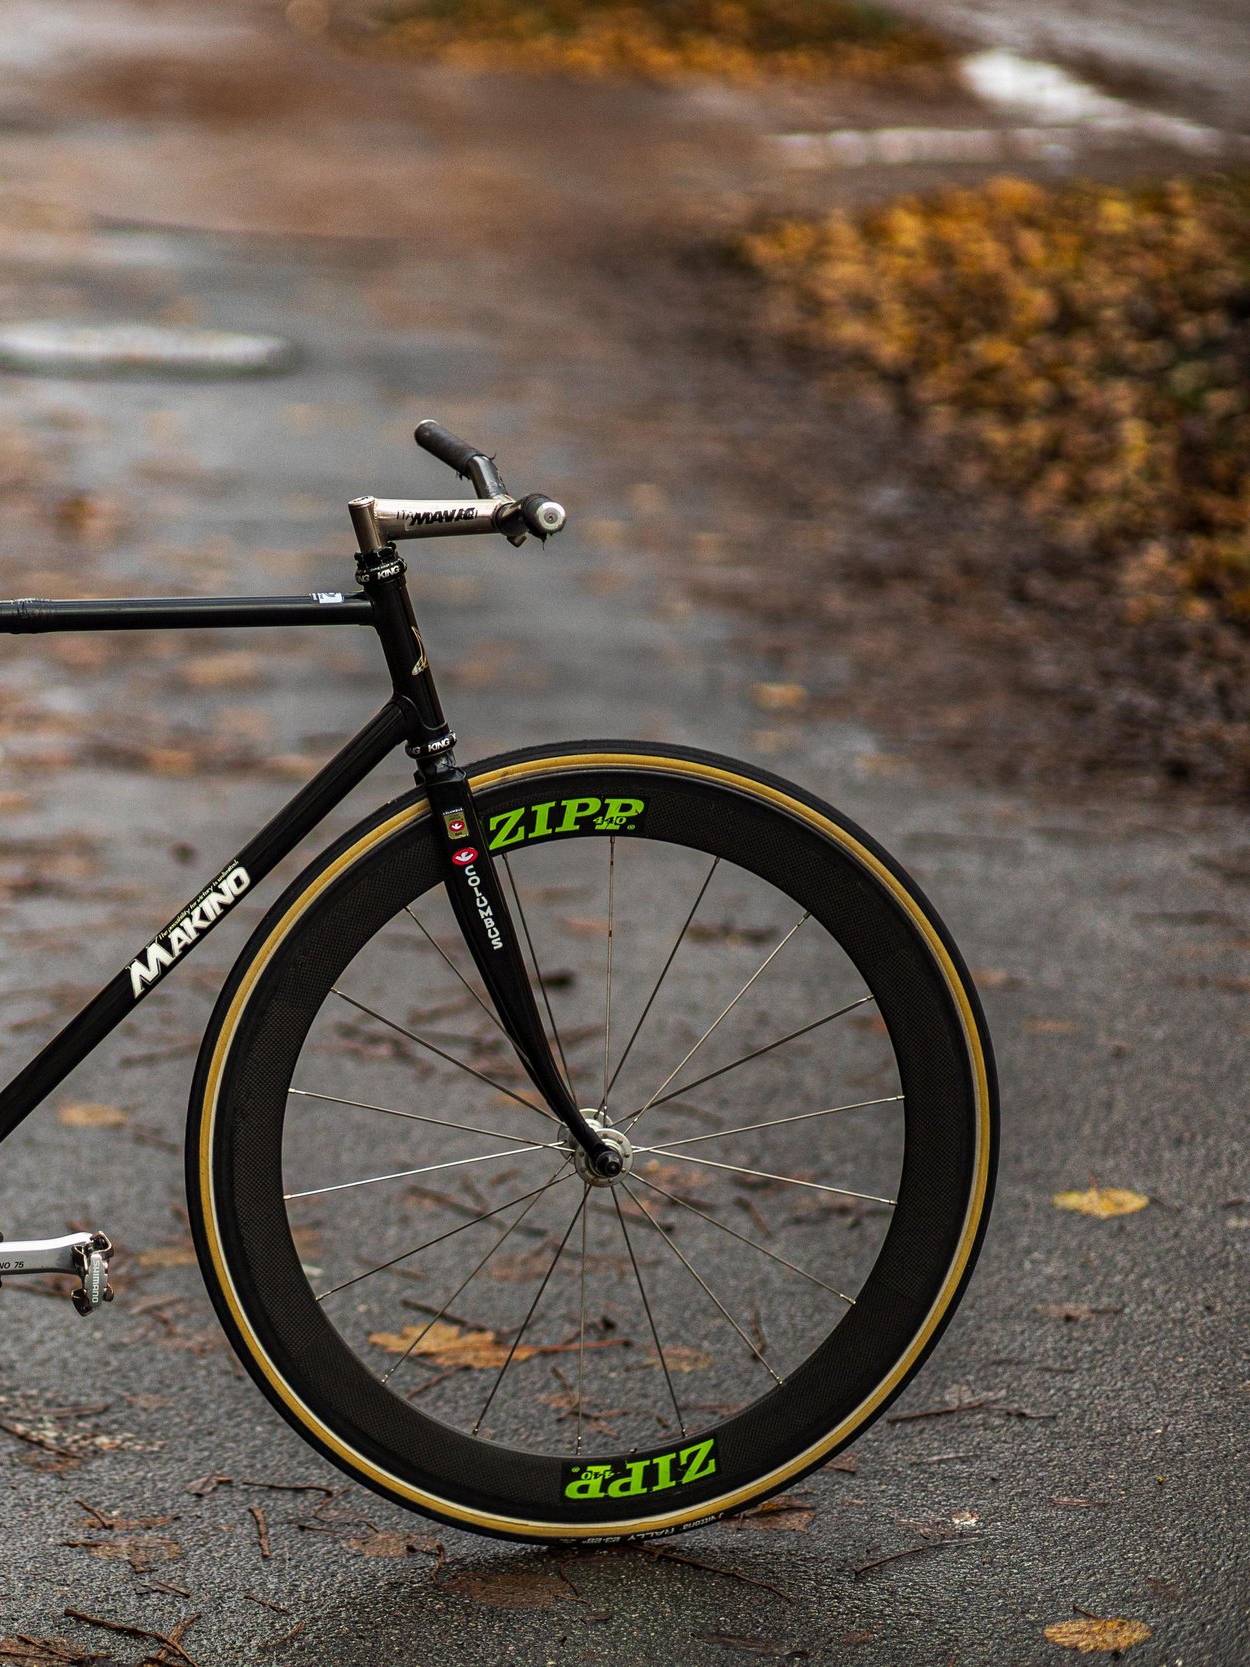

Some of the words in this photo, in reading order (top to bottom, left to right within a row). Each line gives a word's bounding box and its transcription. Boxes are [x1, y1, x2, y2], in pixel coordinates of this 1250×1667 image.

[409, 507, 476, 527] MAVIC
[377, 564, 400, 581] KING
[427, 737, 450, 752] KING
[488, 797, 645, 851] ZIPP
[593, 816, 627, 825] 440
[464, 864, 503, 950] COLUMBUS
[128, 866, 251, 1000] MAKINO
[14, 1260, 25, 1269] 75
[91, 1259, 101, 1304] SHIMANO
[563, 1438, 716, 1499] ZIPP
[627, 1525, 676, 1542] RALLY
